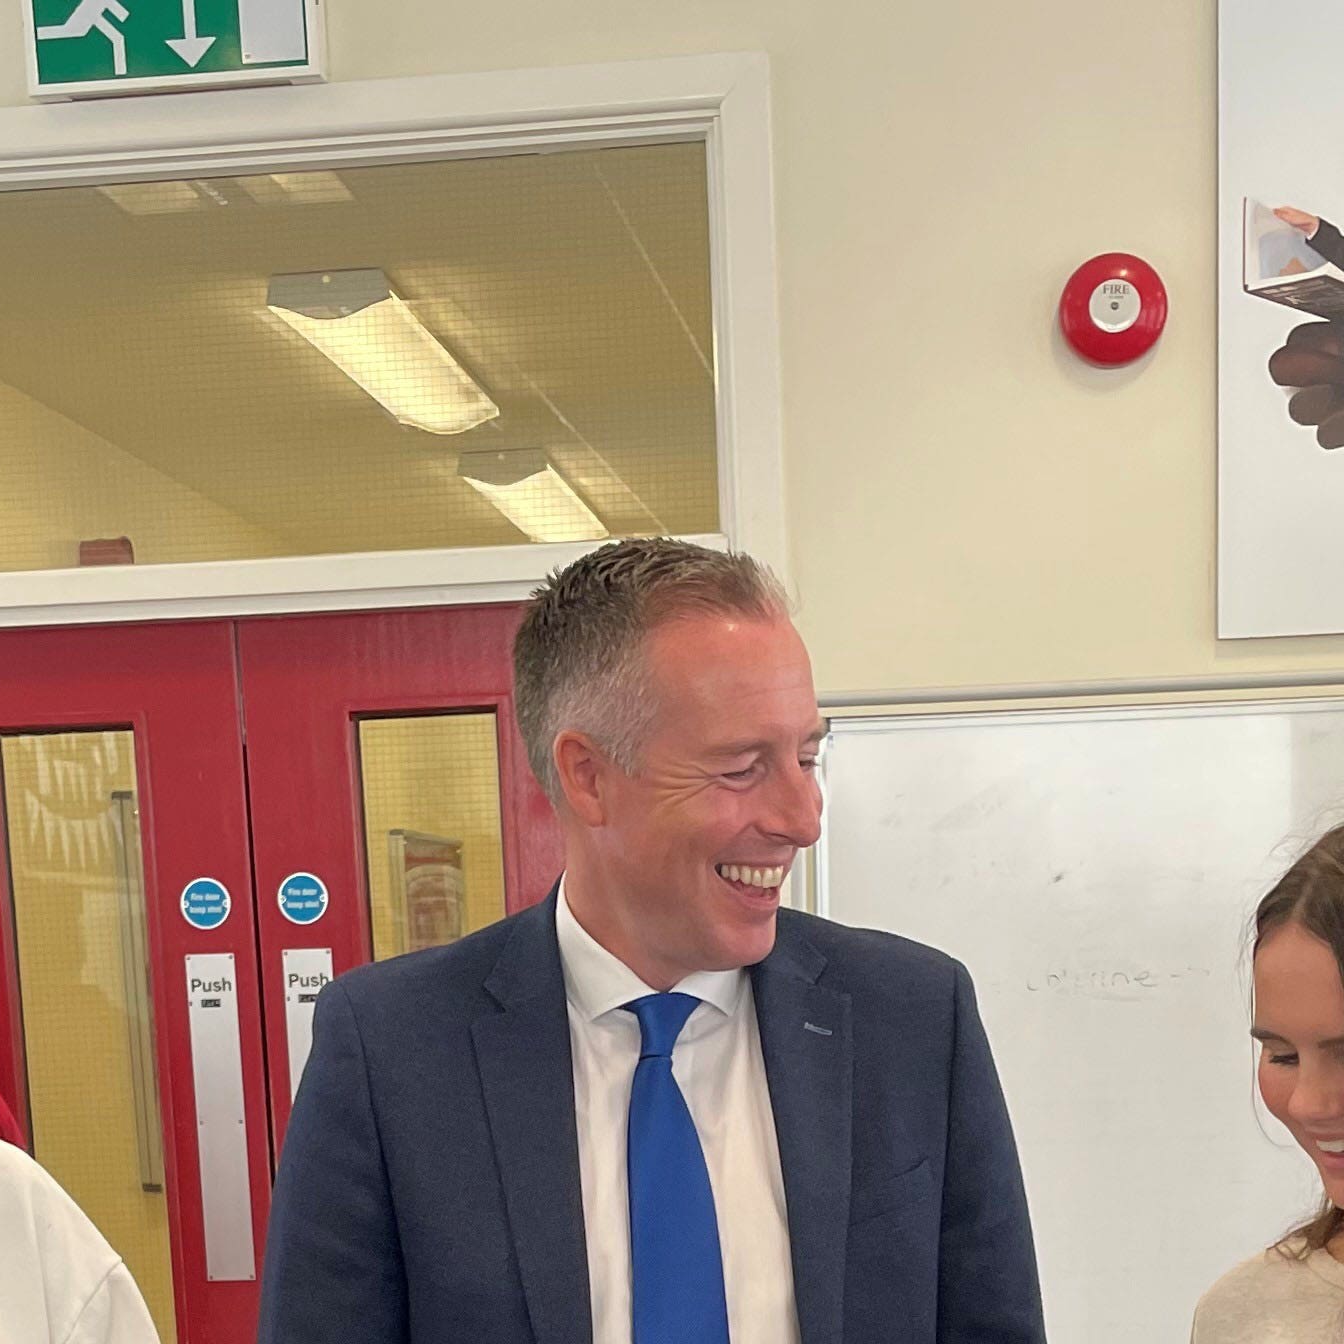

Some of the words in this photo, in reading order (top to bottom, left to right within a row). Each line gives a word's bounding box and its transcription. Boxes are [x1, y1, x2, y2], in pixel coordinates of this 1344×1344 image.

[1103, 284, 1130, 294] FIRE
[191, 978, 231, 992] Push
[288, 973, 329, 987] Push
